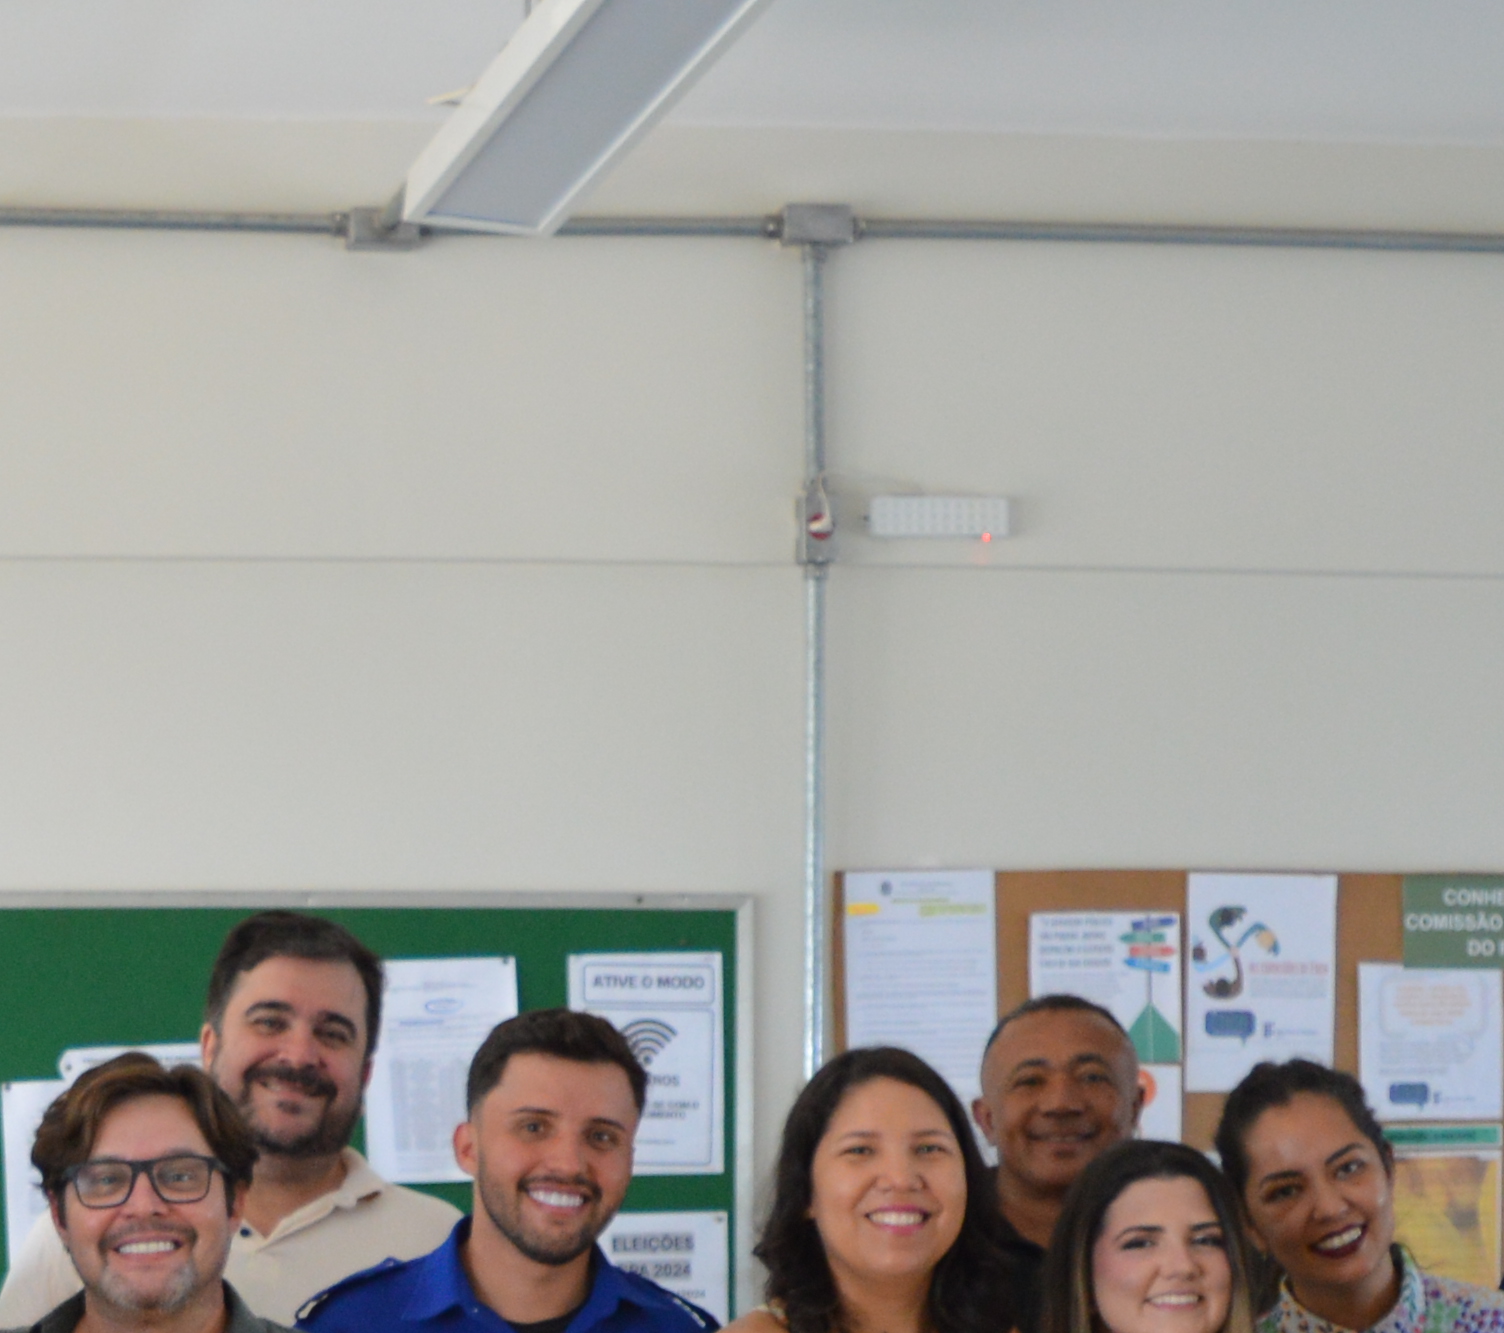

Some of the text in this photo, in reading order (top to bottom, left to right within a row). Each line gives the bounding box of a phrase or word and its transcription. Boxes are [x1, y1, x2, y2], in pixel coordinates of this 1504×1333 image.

[1405, 911, 1503, 931] COMISSÃO
[1467, 939, 1495, 956] DO
[593, 974, 705, 989] ATIVE O MODO
[612, 1234, 694, 1254] ELEIÇÕES
[654, 1262, 691, 1278] 2024
